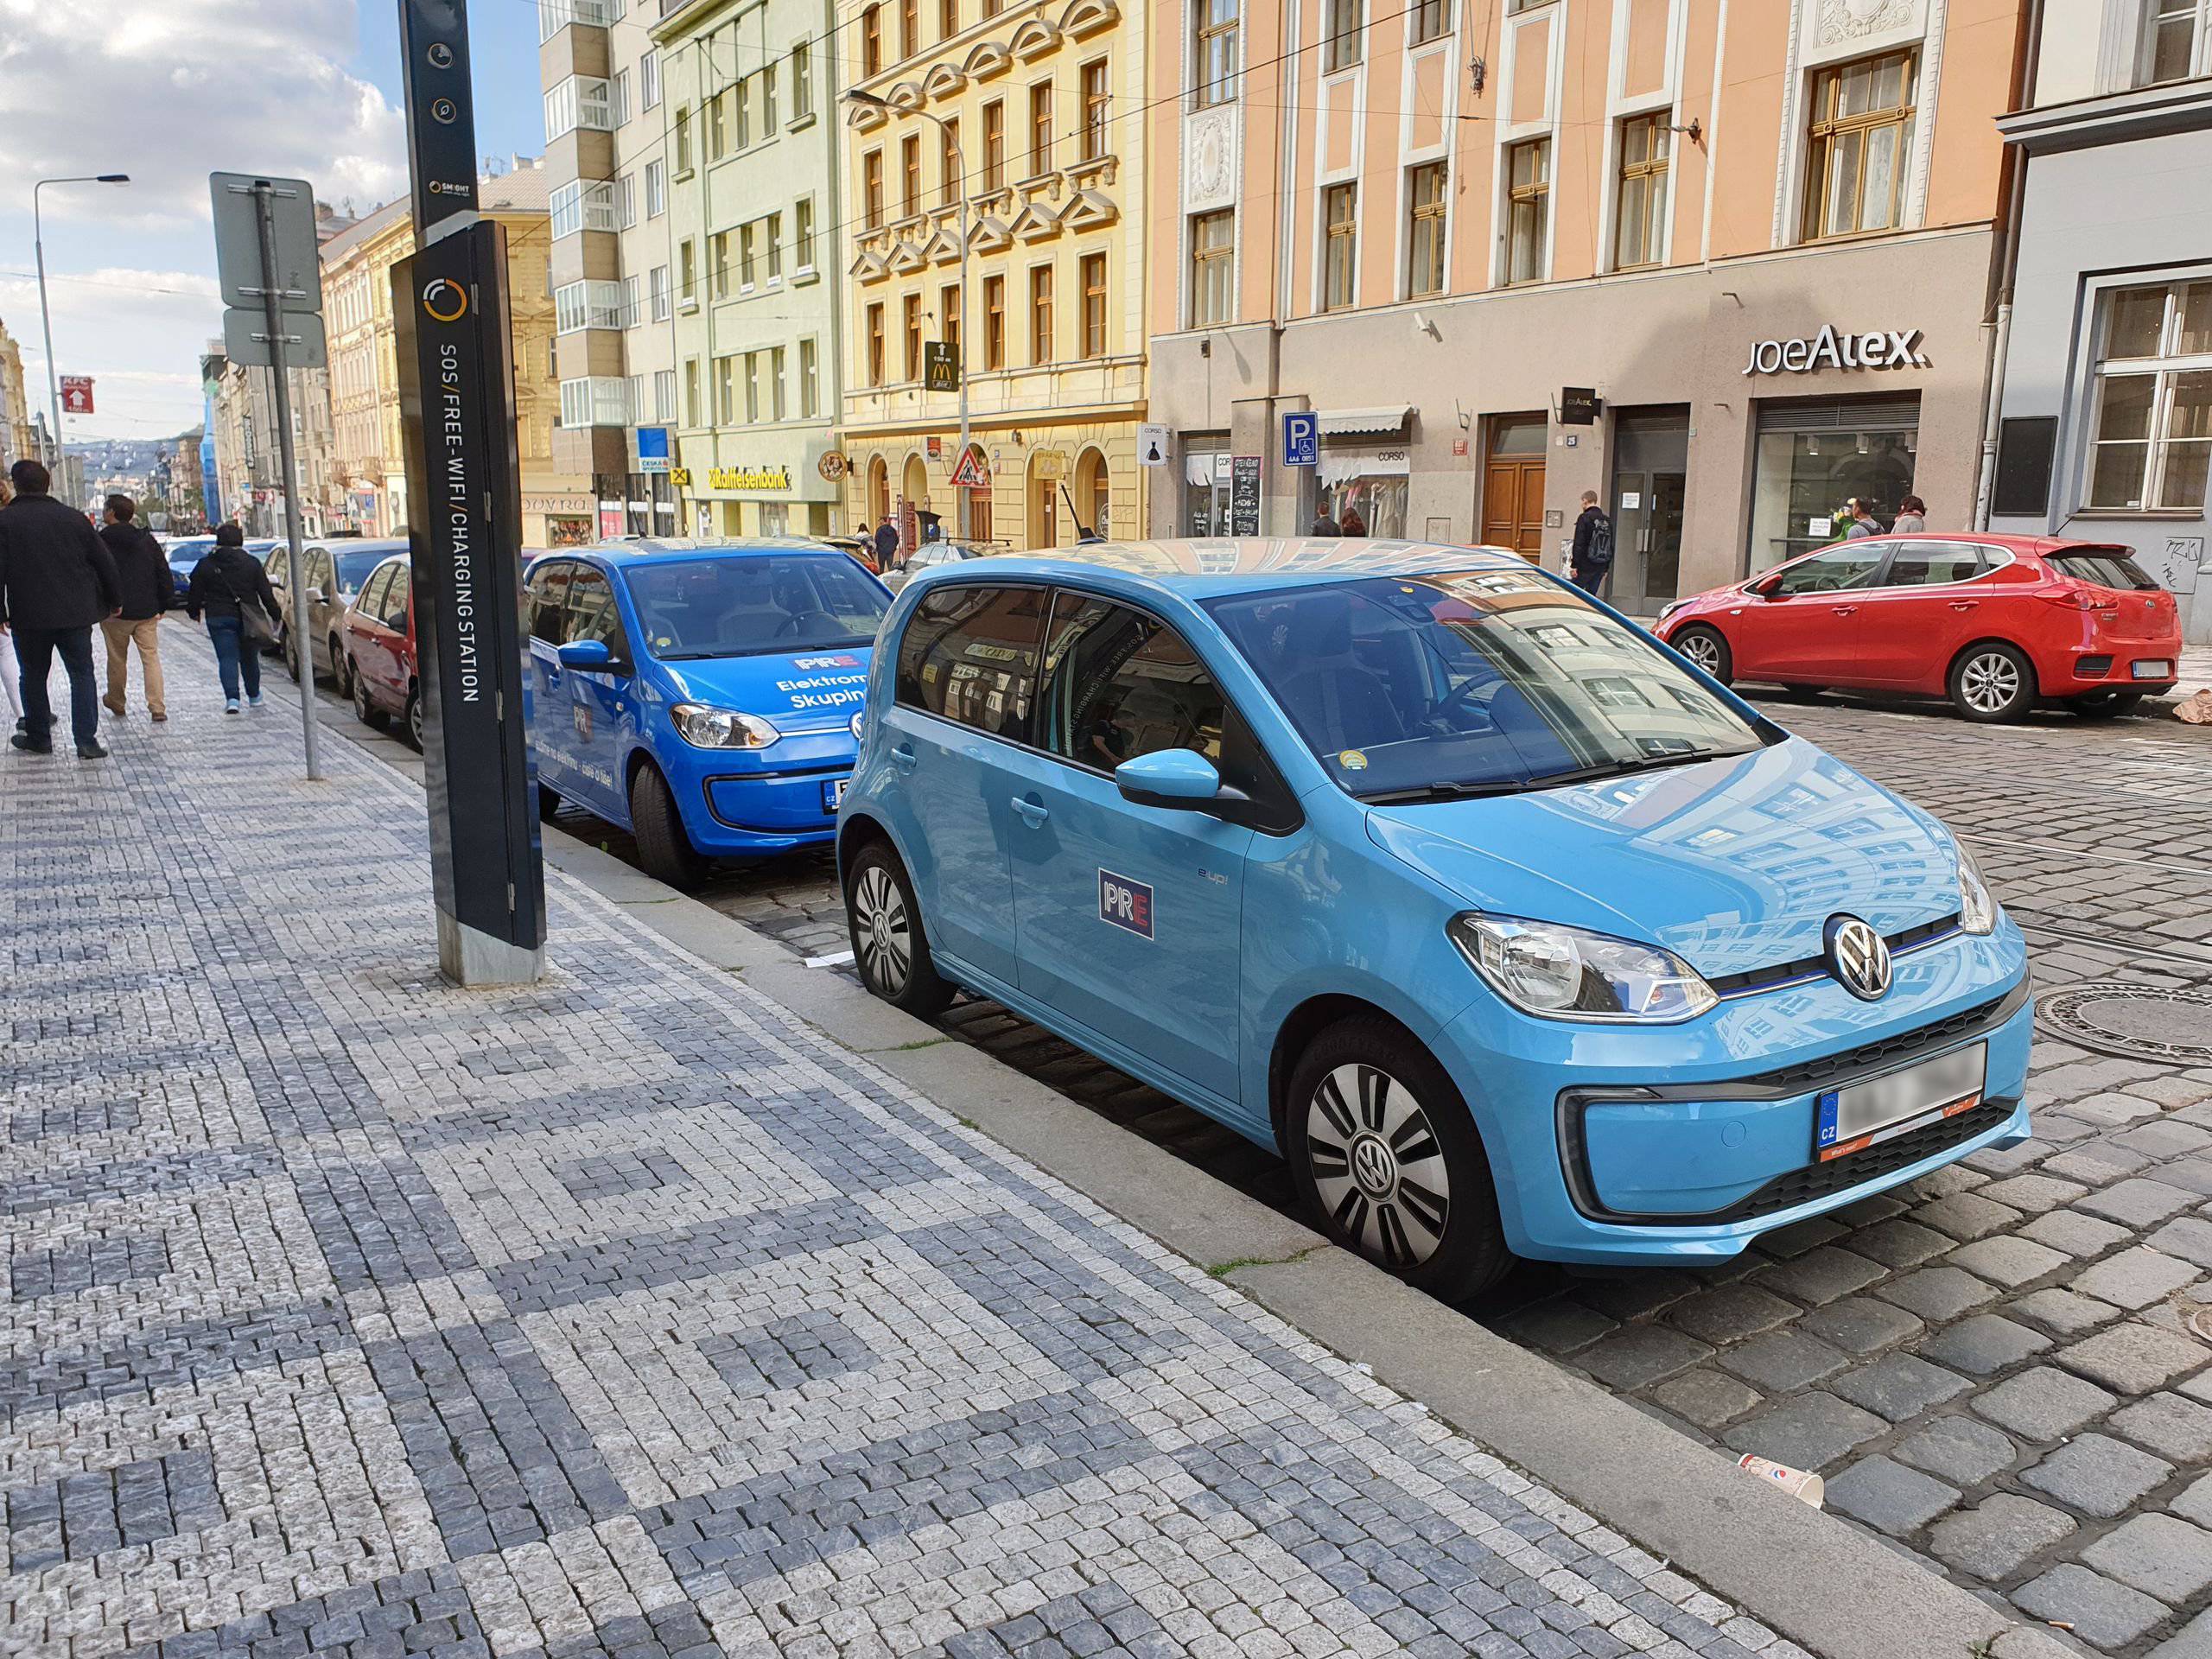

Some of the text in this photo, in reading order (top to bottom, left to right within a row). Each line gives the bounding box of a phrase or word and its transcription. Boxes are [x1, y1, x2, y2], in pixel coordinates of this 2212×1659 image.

[1290, 419, 1311, 450] P
[1377, 451, 1405, 461] CORSO
[795, 656, 858, 670] PRE
[1104, 880, 1148, 926] PRE
[1821, 1126, 1834, 1141] CZ
